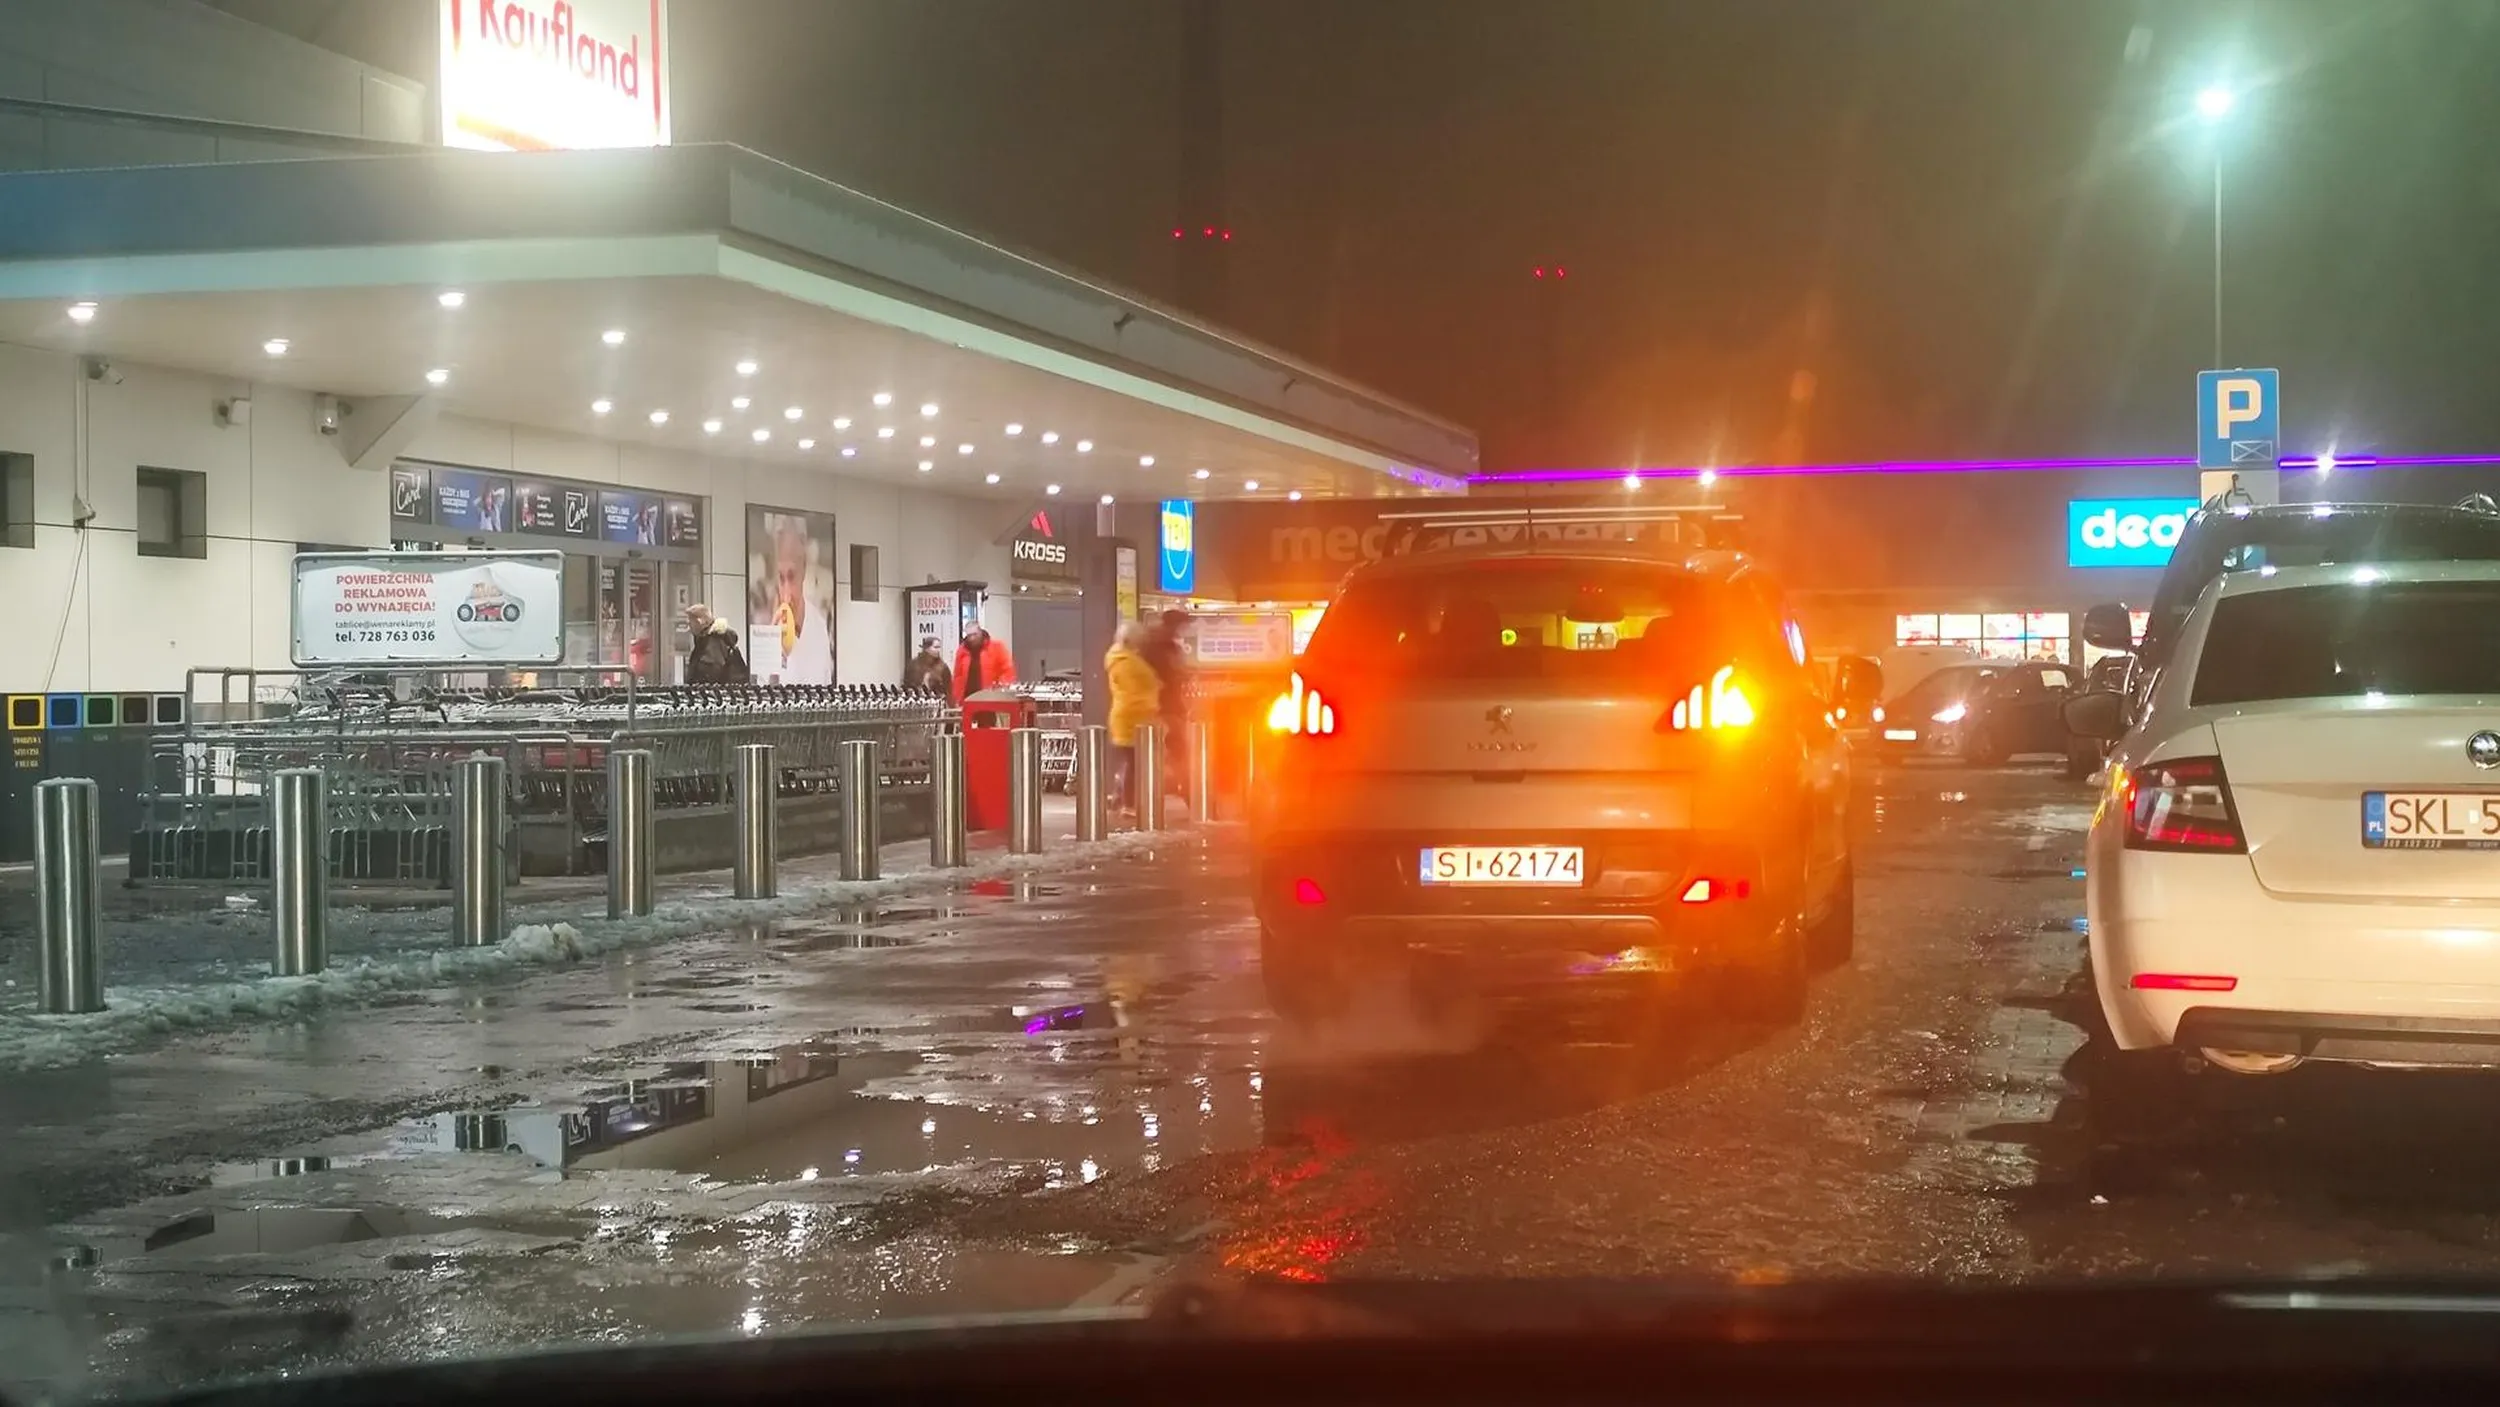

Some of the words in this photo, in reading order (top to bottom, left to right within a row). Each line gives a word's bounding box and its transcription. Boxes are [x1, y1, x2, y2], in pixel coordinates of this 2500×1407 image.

[480, 0, 638, 99] Kaufland
[2217, 379, 2261, 439] P
[2081, 507, 2200, 549] dea
[1014, 540, 1066, 563] KROSS
[336, 573, 434, 585] POWIERZCHNIA
[343, 588, 427, 599] REKLAMOWA
[335, 602, 353, 613] DO
[357, 601, 436, 615] WYNAJĘCIA!
[335, 631, 356, 642] tel.
[360, 631, 382, 642] 728
[386, 631, 409, 642] 763
[412, 630, 436, 642] 036
[2368, 820, 2384, 833] PL
[2389, 798, 2465, 835] SKL
[2481, 798, 2500, 835] 5
[1438, 851, 1471, 877] SI
[1489, 851, 1578, 877] 62174
